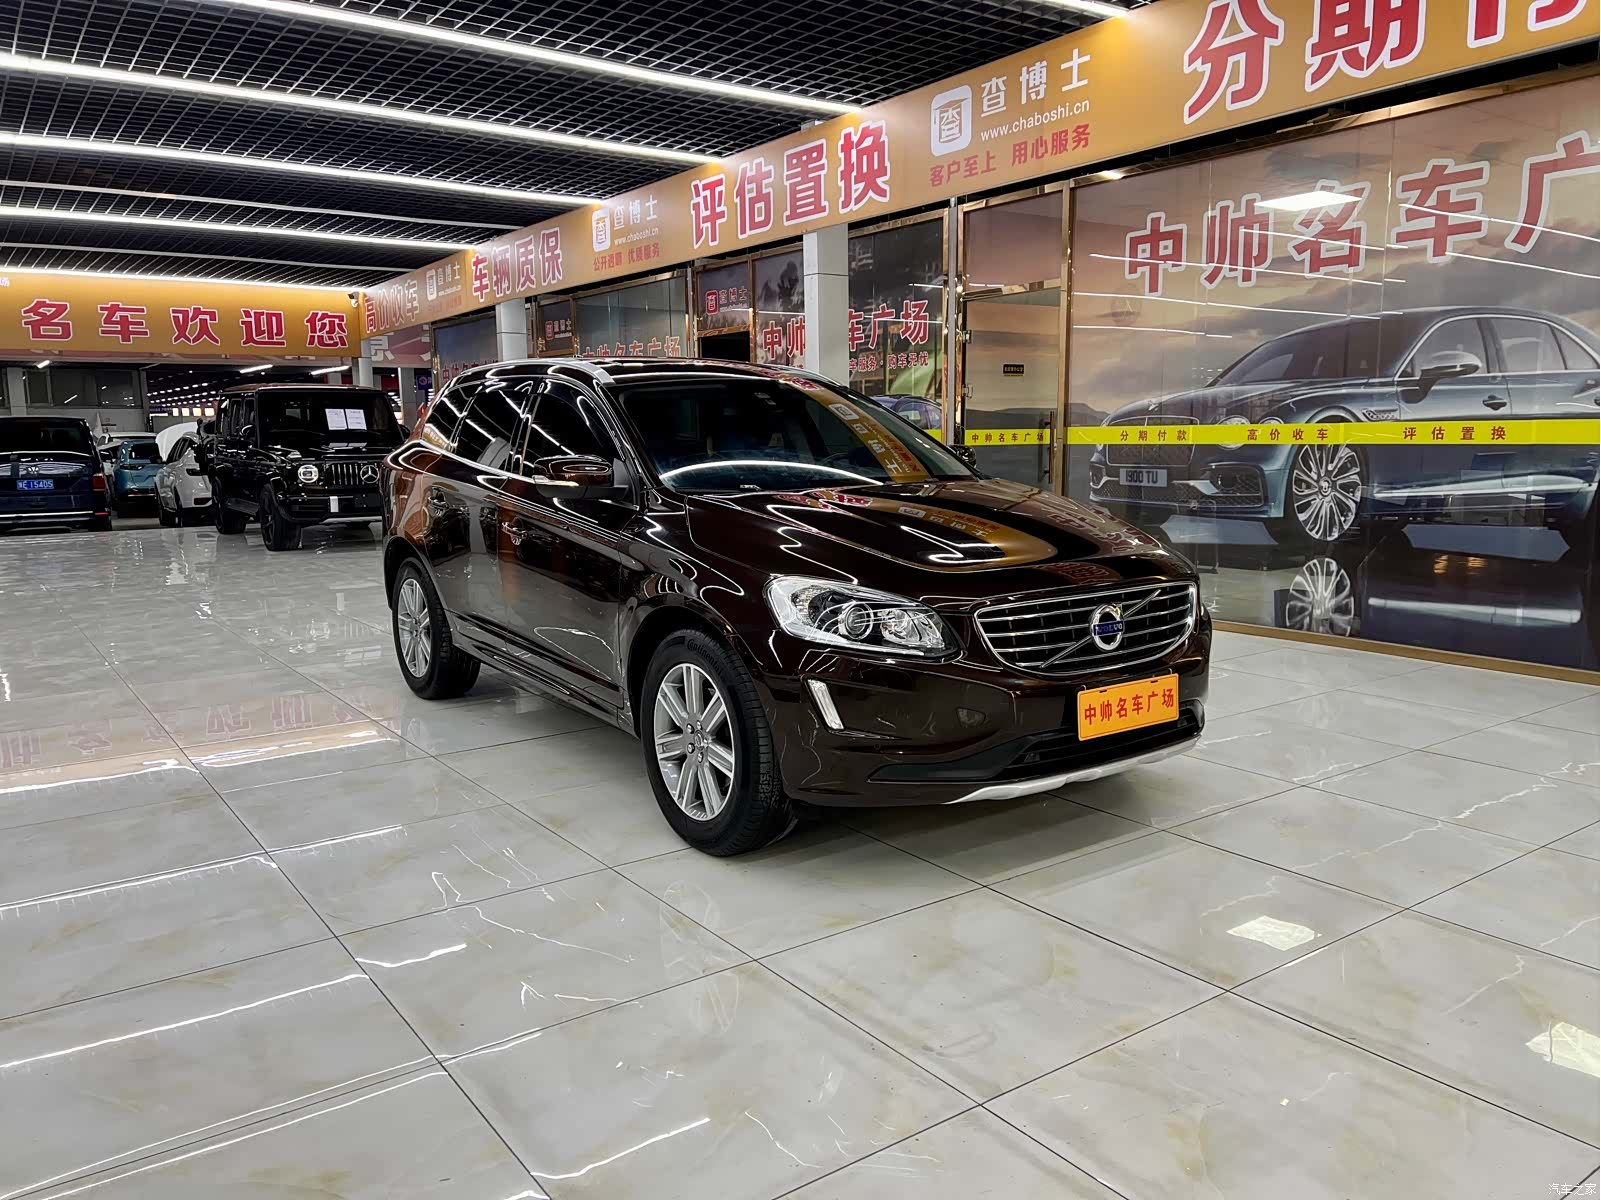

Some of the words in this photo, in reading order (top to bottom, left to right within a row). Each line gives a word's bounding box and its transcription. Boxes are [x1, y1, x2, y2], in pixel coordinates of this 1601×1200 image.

[981, 48, 1091, 117] 查博士
[981, 100, 1090, 141] www.chaboshi.cn
[929, 150, 997, 187] 客户至上
[1011, 123, 1091, 166] 用心服务
[690, 119, 891, 249] 评估置换
[614, 194, 658, 230] 查博士
[471, 226, 563, 303] 车辆质保
[21, 298, 349, 349] 名车欢迎您
[365, 279, 419, 334] 高价收车
[971, 432, 1045, 443] 中帅名车广场
[1120, 429, 1187, 442] 分期付款
[1247, 428, 1329, 442] 高价收车
[1403, 426, 1507, 442] 评估置换
[1145, 470, 1158, 485] TU
[1095, 622, 1123, 636] VOLVO
[1084, 688, 1174, 725] 中帅名车广场
